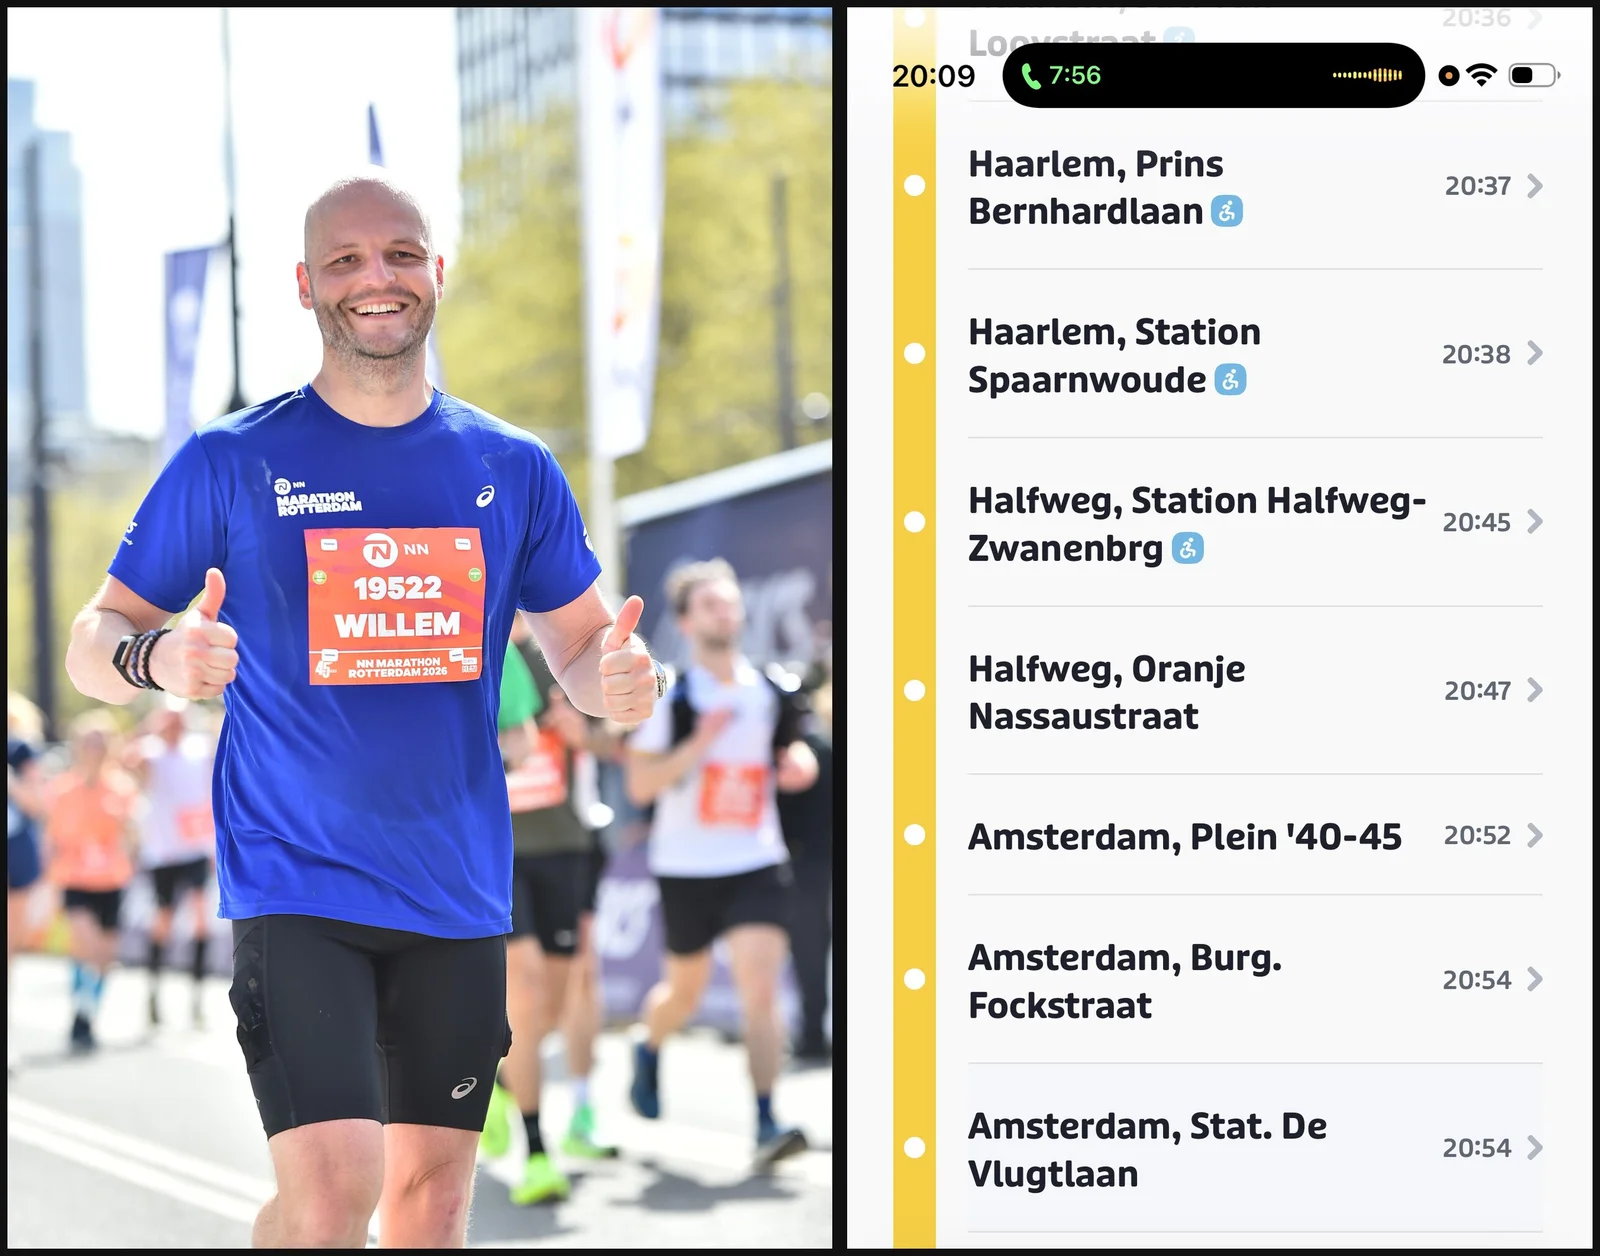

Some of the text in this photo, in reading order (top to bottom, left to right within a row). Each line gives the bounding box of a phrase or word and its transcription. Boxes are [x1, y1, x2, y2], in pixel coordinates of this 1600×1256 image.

[1442, 8, 1512, 28] 20:36
[892, 64, 976, 89] 20:09
[1049, 65, 1101, 85] 7:56
[969, 149, 1224, 184] Haarlem, Prins
[1445, 175, 1512, 196] 20:37
[969, 196, 1203, 225] Bernhardlaan
[969, 317, 1261, 352] Haarlem, Station
[1442, 344, 1511, 365] 20:38
[968, 365, 1207, 400] Spaarnwoude
[292, 481, 306, 489] NN
[276, 491, 355, 506] MARATHON
[277, 501, 363, 517] ROTTERDAM
[969, 485, 1427, 521] Halfweg, Station Halfweg-
[1443, 512, 1511, 533] 20:45
[403, 543, 430, 555] NN
[968, 533, 1163, 569] Zwanenbrg
[354, 576, 442, 601] 19522
[334, 611, 460, 638] WILLEM
[348, 666, 448, 679] ROTTERDAM 2026
[356, 657, 441, 668] NN MARATHON
[969, 654, 1246, 689] Halfweg, Oranje
[1444, 680, 1512, 701] 20:47
[969, 701, 1200, 730] Nassaustraat
[967, 822, 1403, 857] Amsterdam, Plein '40-45
[1444, 824, 1511, 846] 20:52
[967, 943, 1282, 978] Amsterdam, Burg.
[1443, 969, 1513, 990] 20:54
[969, 991, 1153, 1020] Fockstraat
[967, 1111, 1328, 1146] Amsterdam, Stat. De
[1443, 1137, 1513, 1158] 20:54
[967, 1159, 1138, 1194] Vlugtlaan
